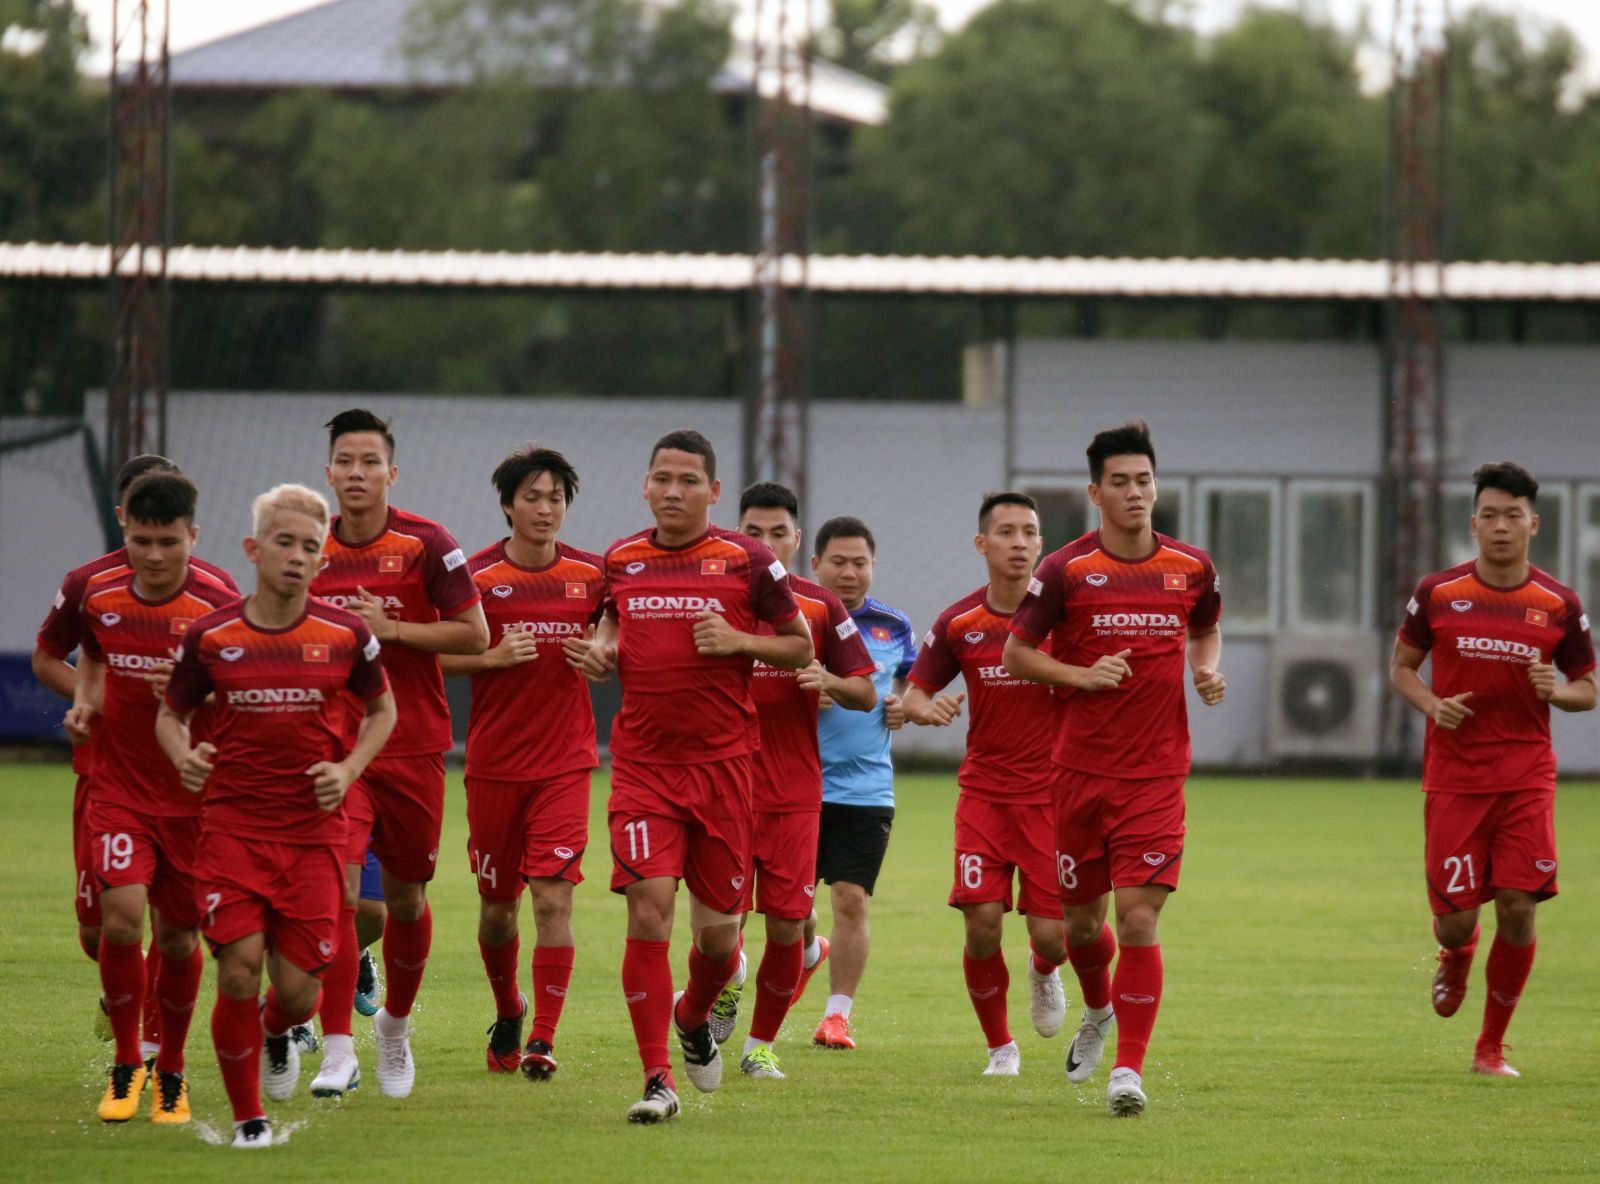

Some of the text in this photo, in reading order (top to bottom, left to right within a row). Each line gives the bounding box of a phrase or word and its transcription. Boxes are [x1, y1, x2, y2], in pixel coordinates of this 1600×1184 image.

[626, 596, 726, 612] HONDA
[631, 612, 646, 620] The
[646, 611, 673, 620] Power
[674, 611, 685, 619] of
[1091, 613, 1182, 627] HONDA
[502, 622, 582, 635] HONDA
[1096, 628, 1179, 636] The Power of Dreams
[1456, 636, 1541, 658] HONDA
[1459, 650, 1475, 658] The
[1475, 651, 1501, 661] Power
[1501, 654, 1511, 662] of
[769, 670, 779, 678] of
[996, 679, 1021, 687] Power
[225, 688, 325, 704] HONDA
[624, 820, 650, 861] 11
[101, 832, 134, 872] 19
[959, 853, 983, 889] 16
[1443, 853, 1475, 893] 21
